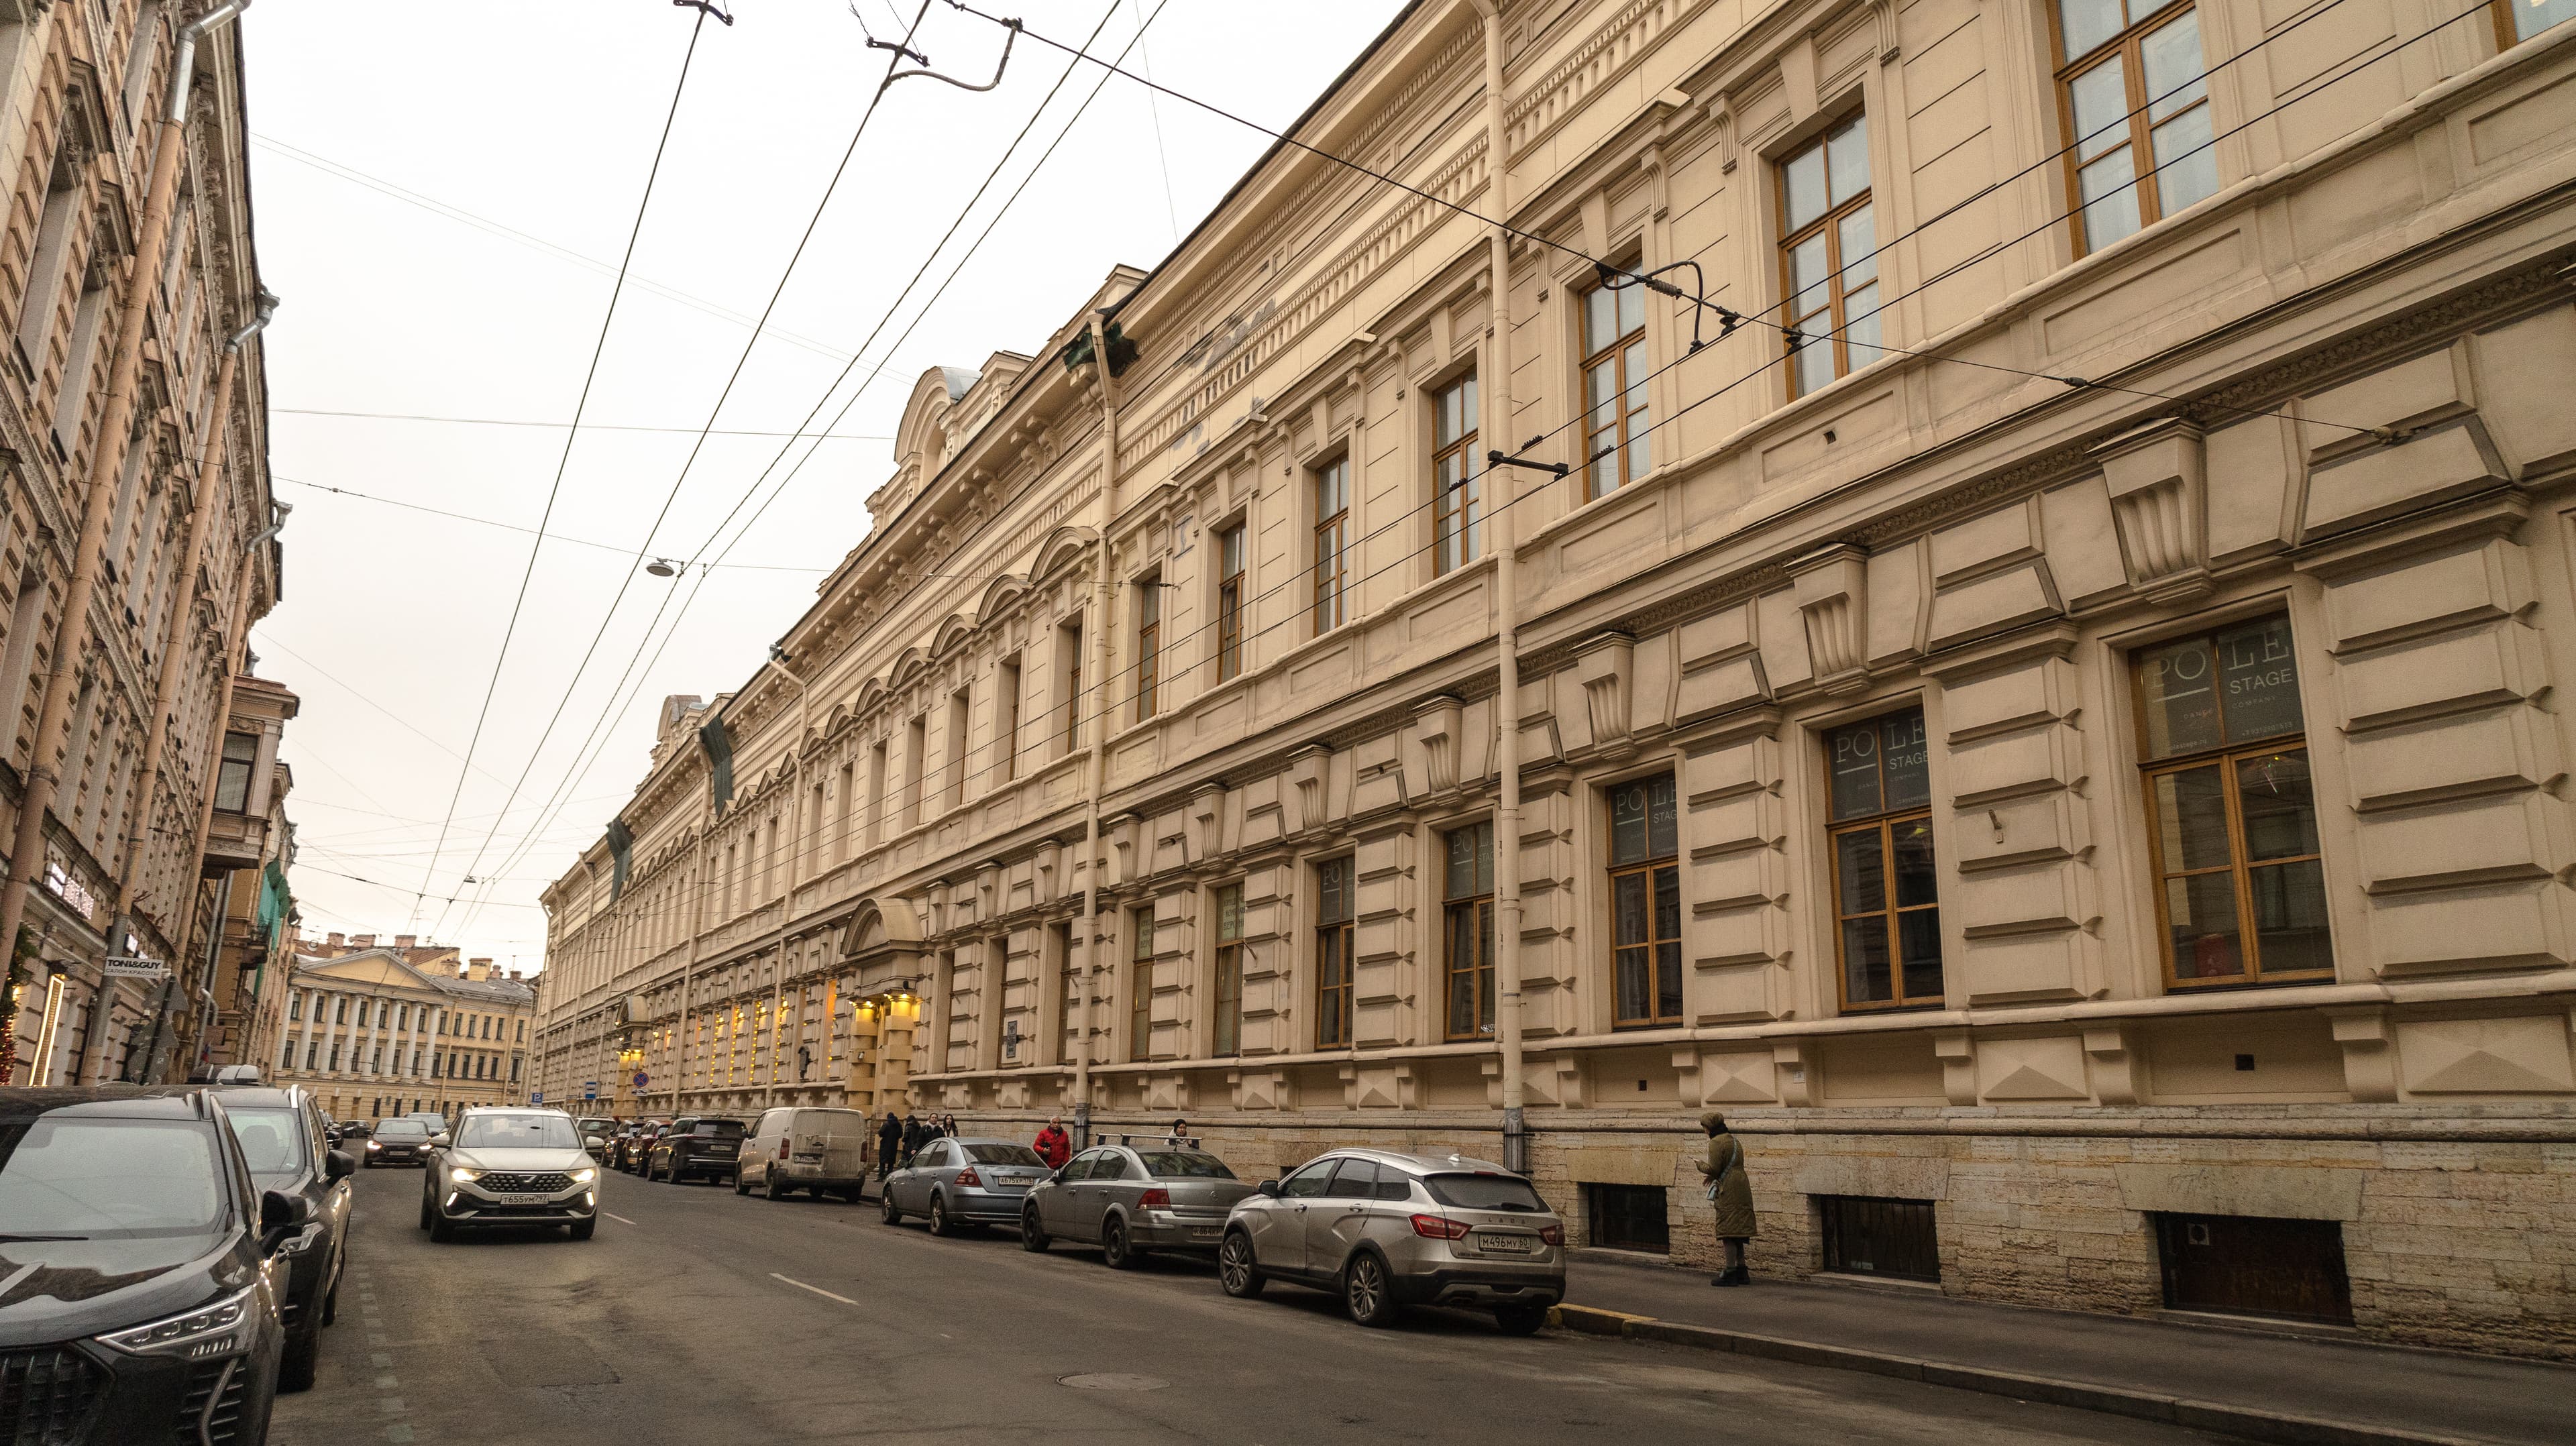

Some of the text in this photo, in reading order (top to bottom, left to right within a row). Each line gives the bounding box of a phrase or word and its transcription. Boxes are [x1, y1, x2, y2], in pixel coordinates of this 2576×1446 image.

[2152, 629, 2289, 688] POLE
[2229, 668, 2293, 694] STAGE
[1836, 716, 1927, 763] POLE
[107, 959, 161, 969] TONI&GUY
[1483, 1237, 1527, 1247] М496МУ 60
